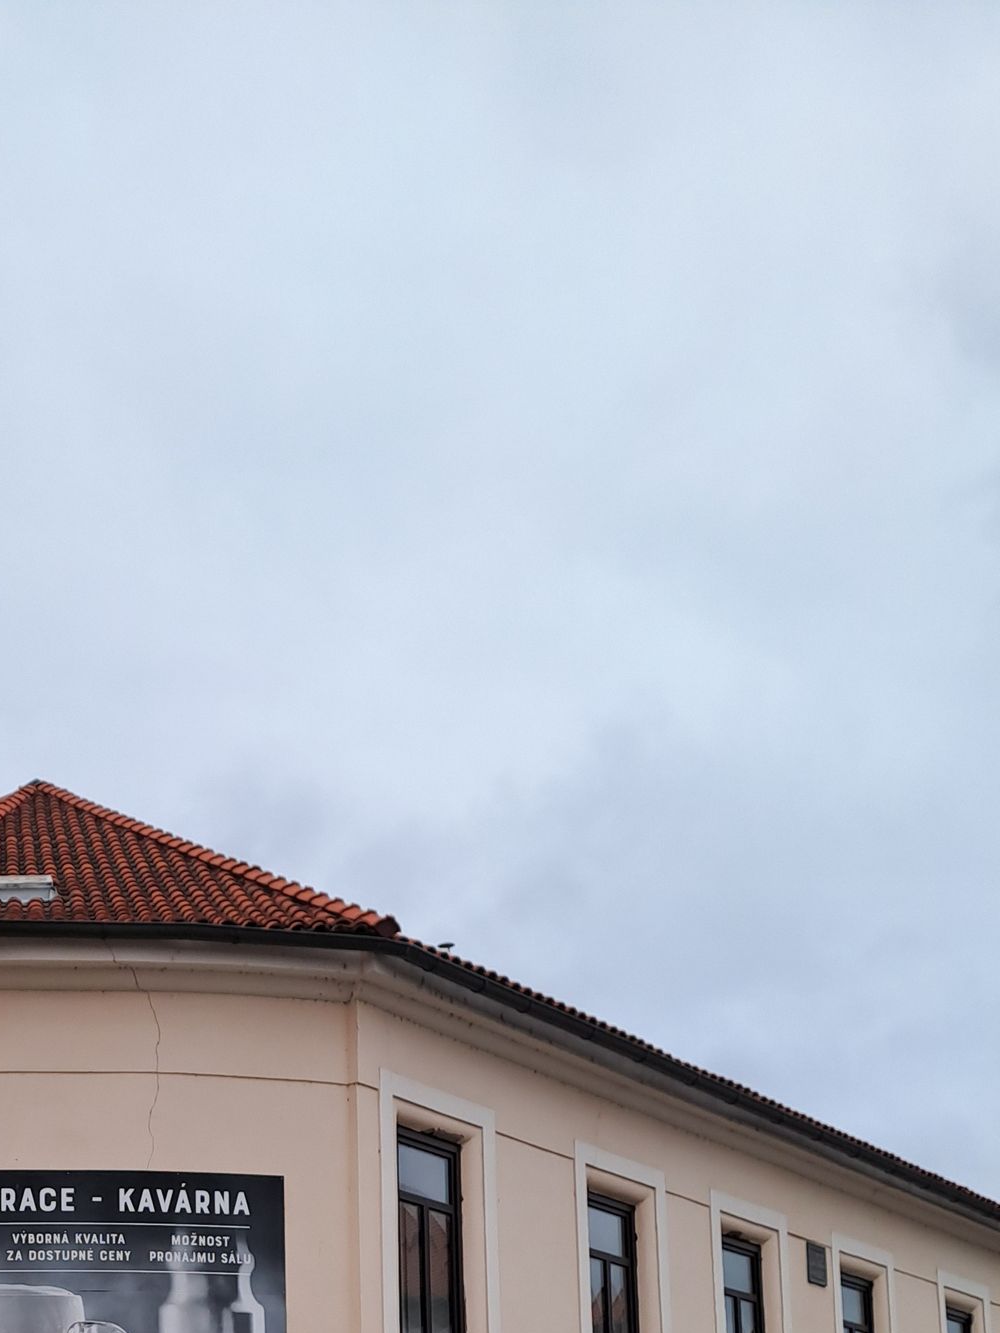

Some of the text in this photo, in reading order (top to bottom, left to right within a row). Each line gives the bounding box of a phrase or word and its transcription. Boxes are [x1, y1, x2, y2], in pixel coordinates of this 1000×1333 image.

[118, 1182, 251, 1216] KAVÁRNA
[12, 1230, 126, 1245] VÝBORNÁ KVALITA
[171, 1232, 230, 1247] MOŽNOST
[6, 1247, 131, 1261] ZA DOSTUPNÉ CENY
[149, 1248, 251, 1265] PRONÁJMU SÁLU
